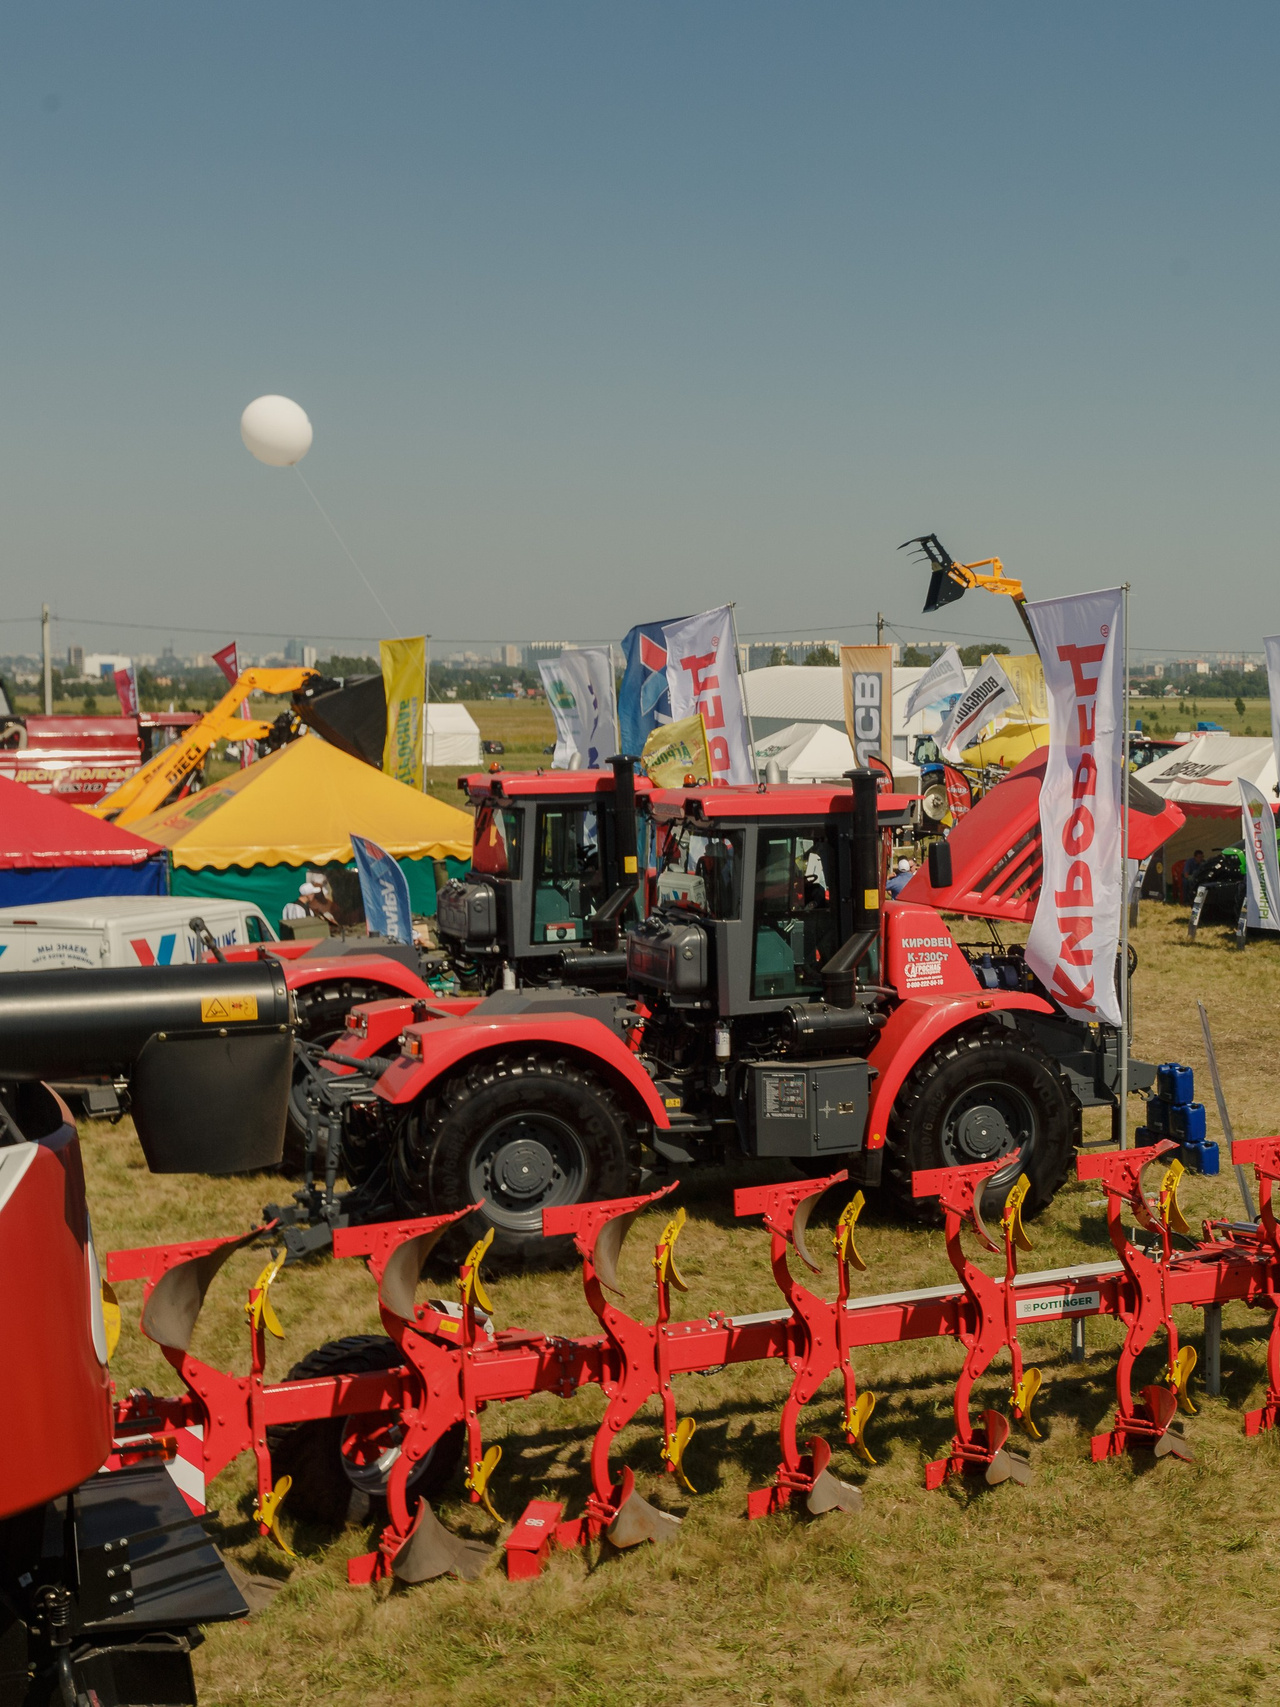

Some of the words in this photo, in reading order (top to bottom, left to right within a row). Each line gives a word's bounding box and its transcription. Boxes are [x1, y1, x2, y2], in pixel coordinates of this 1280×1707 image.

[165, 747, 202, 785] DIECI
[901, 937, 952, 948] КИРОВЕЦ
[907, 952, 949, 962] К-730Ст
